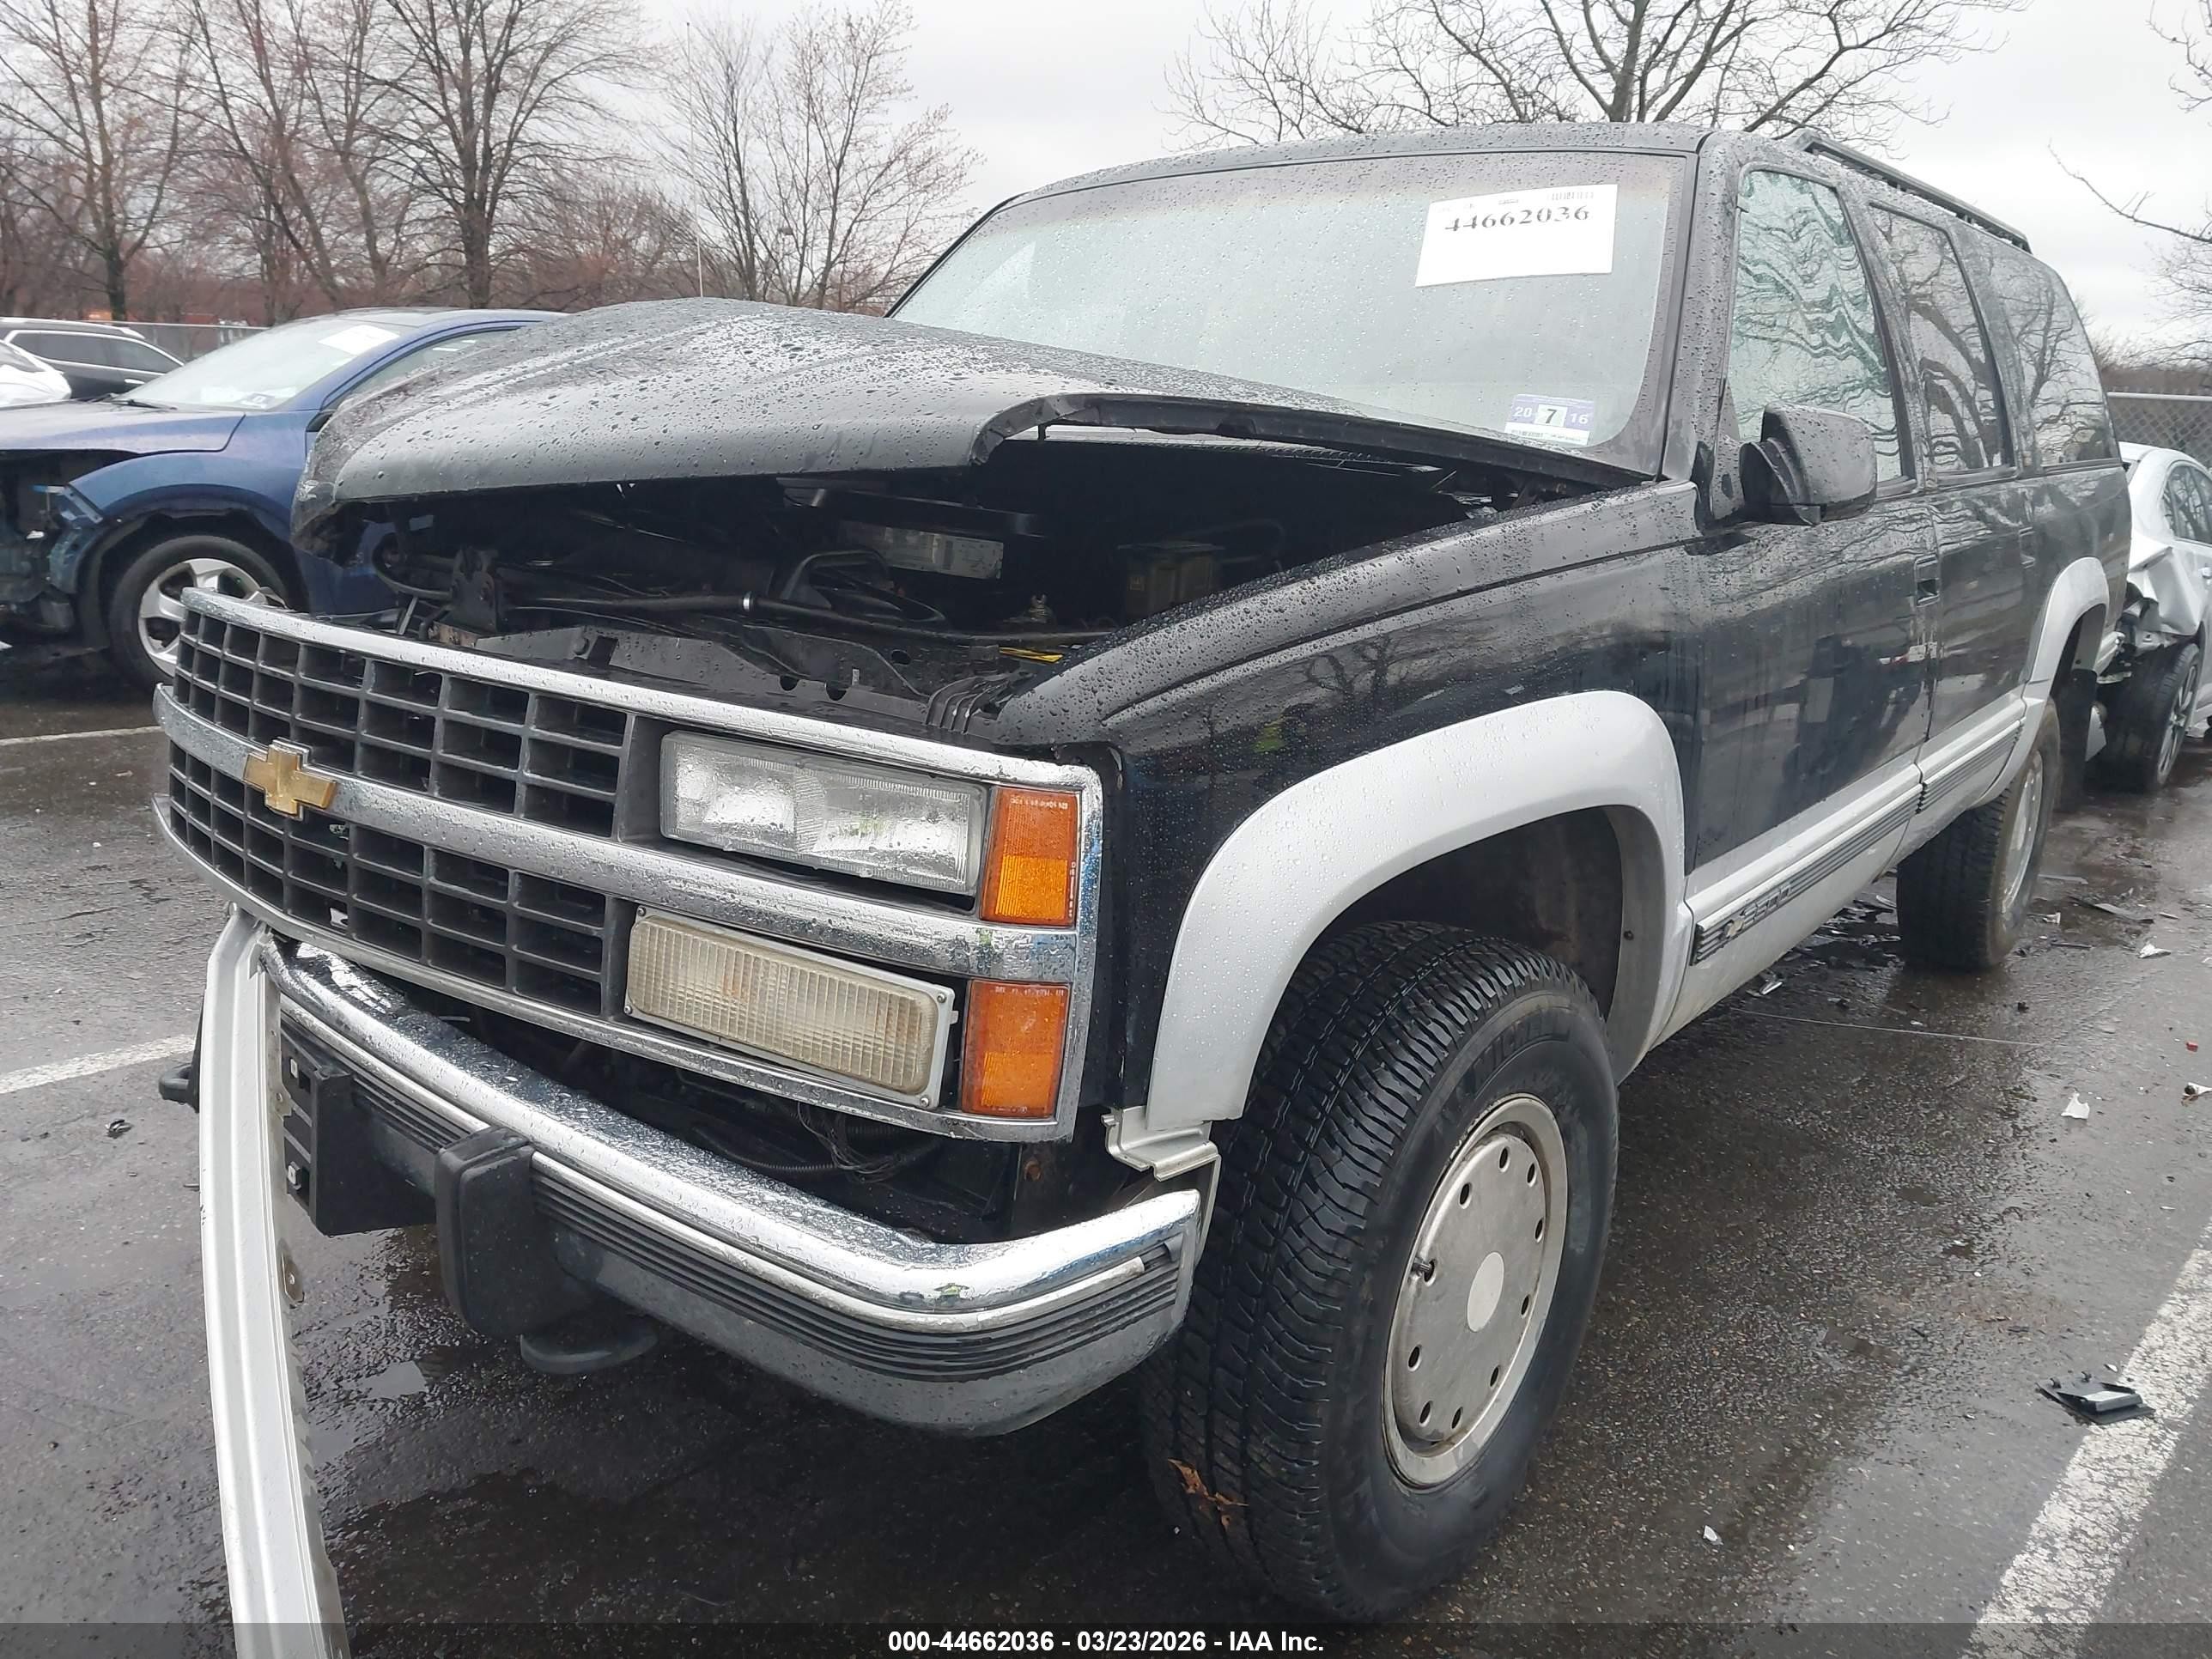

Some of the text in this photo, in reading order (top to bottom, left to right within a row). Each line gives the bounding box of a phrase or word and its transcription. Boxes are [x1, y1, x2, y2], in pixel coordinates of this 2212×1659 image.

[1444, 205, 1589, 232] 44662036
[1513, 407, 1589, 425] 20 7 16
